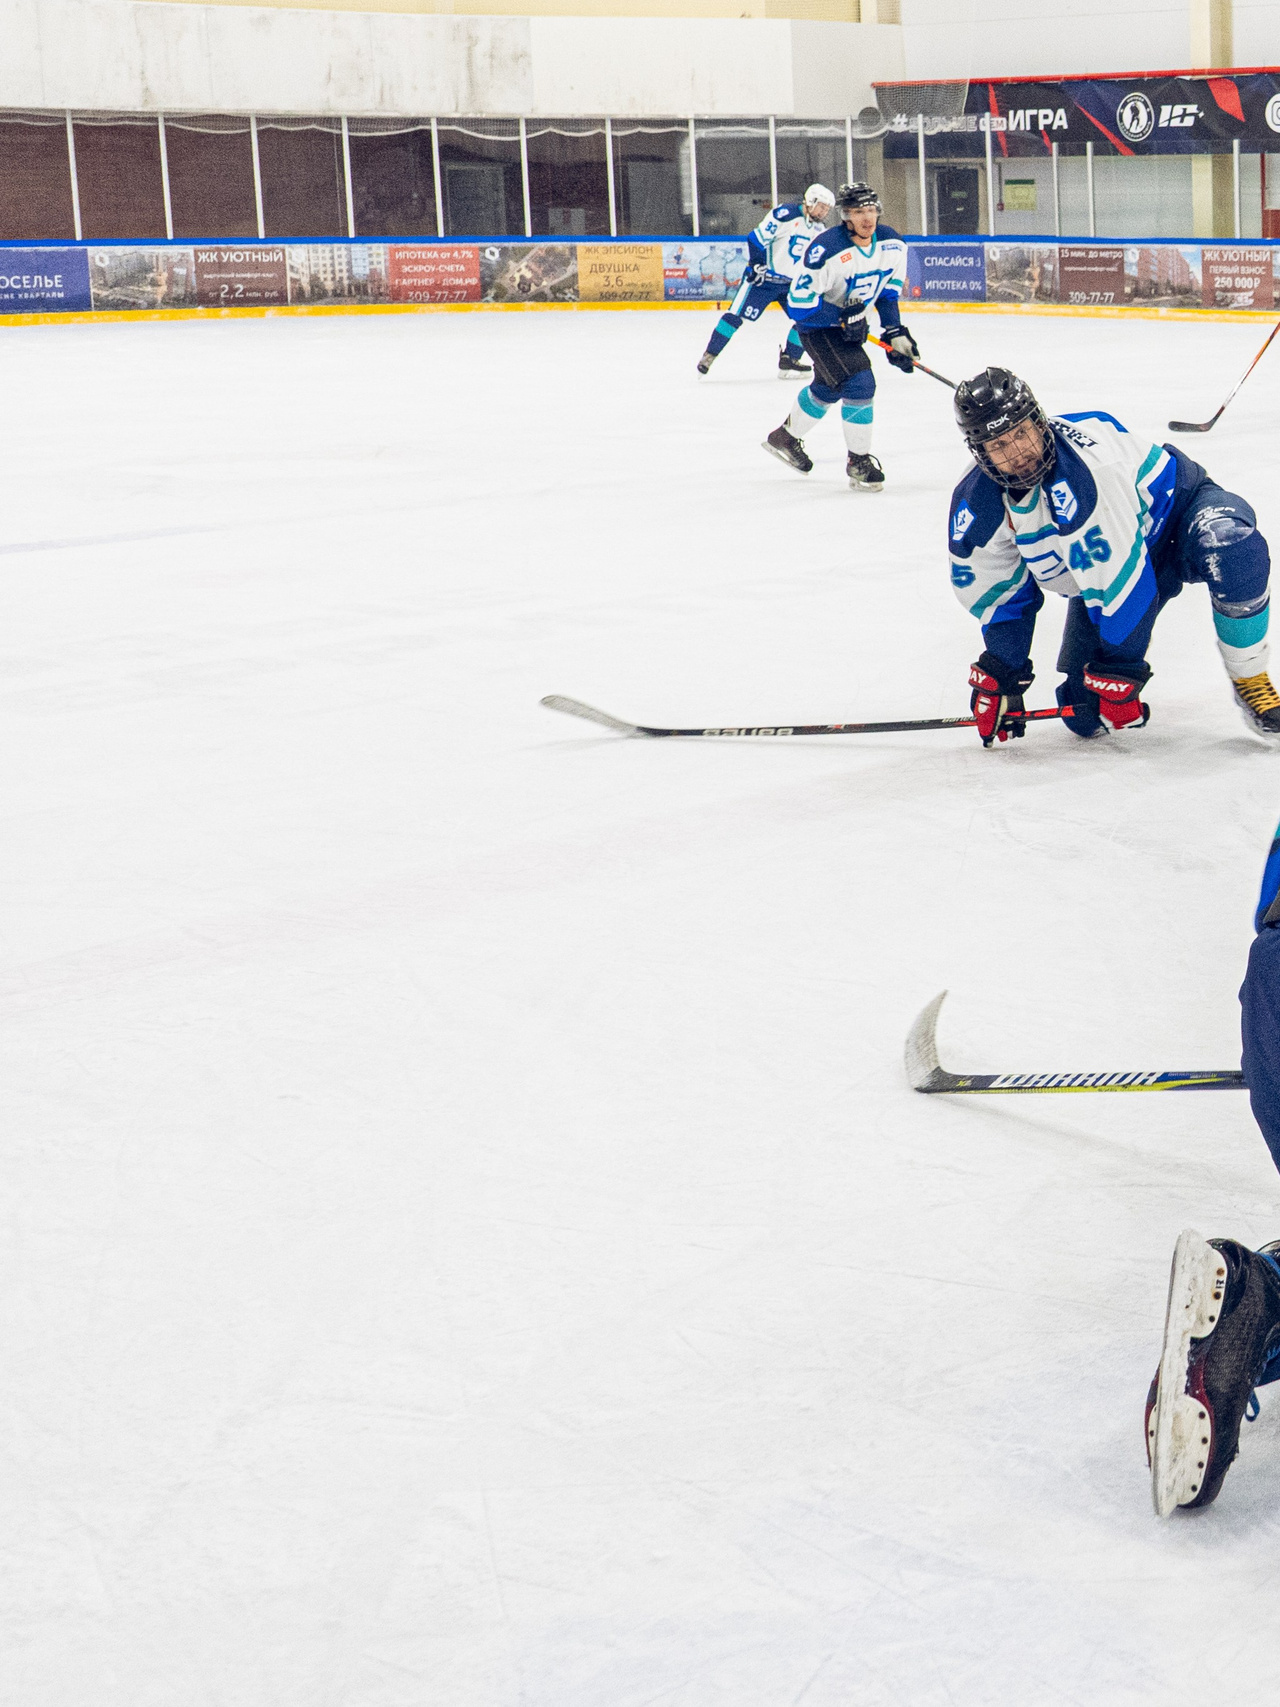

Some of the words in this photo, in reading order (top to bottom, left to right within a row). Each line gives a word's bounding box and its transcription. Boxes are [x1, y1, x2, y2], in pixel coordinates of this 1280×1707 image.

[1008, 108, 1068, 131] ИГРА
[765, 221, 778, 235] 93
[197, 251, 219, 262] ЖК
[220, 249, 283, 263] УЮТНЫЙ
[395, 251, 439, 260] ИПОТЕКА
[584, 245, 600, 255] ЖК
[602, 245, 653, 255] ЭПСИЛОН
[1061, 248, 1070, 258] 15
[1204, 250, 1220, 262] ЖК
[1221, 250, 1271, 262] УЮТНЫЙ
[924, 255, 974, 267] СПАСАЙСЯ
[590, 263, 640, 274] ДВУШКА
[925, 280, 967, 290] ИПОТЕКА
[1214, 277, 1233, 288] 250
[220, 284, 245, 299] 2,2
[408, 289, 468, 302] 309-77-77
[1069, 291, 1115, 303] 309-77-77
[744, 305, 760, 319] 93
[1069, 524, 1112, 572] 45
[987, 1071, 1165, 1089] WARRIOR
